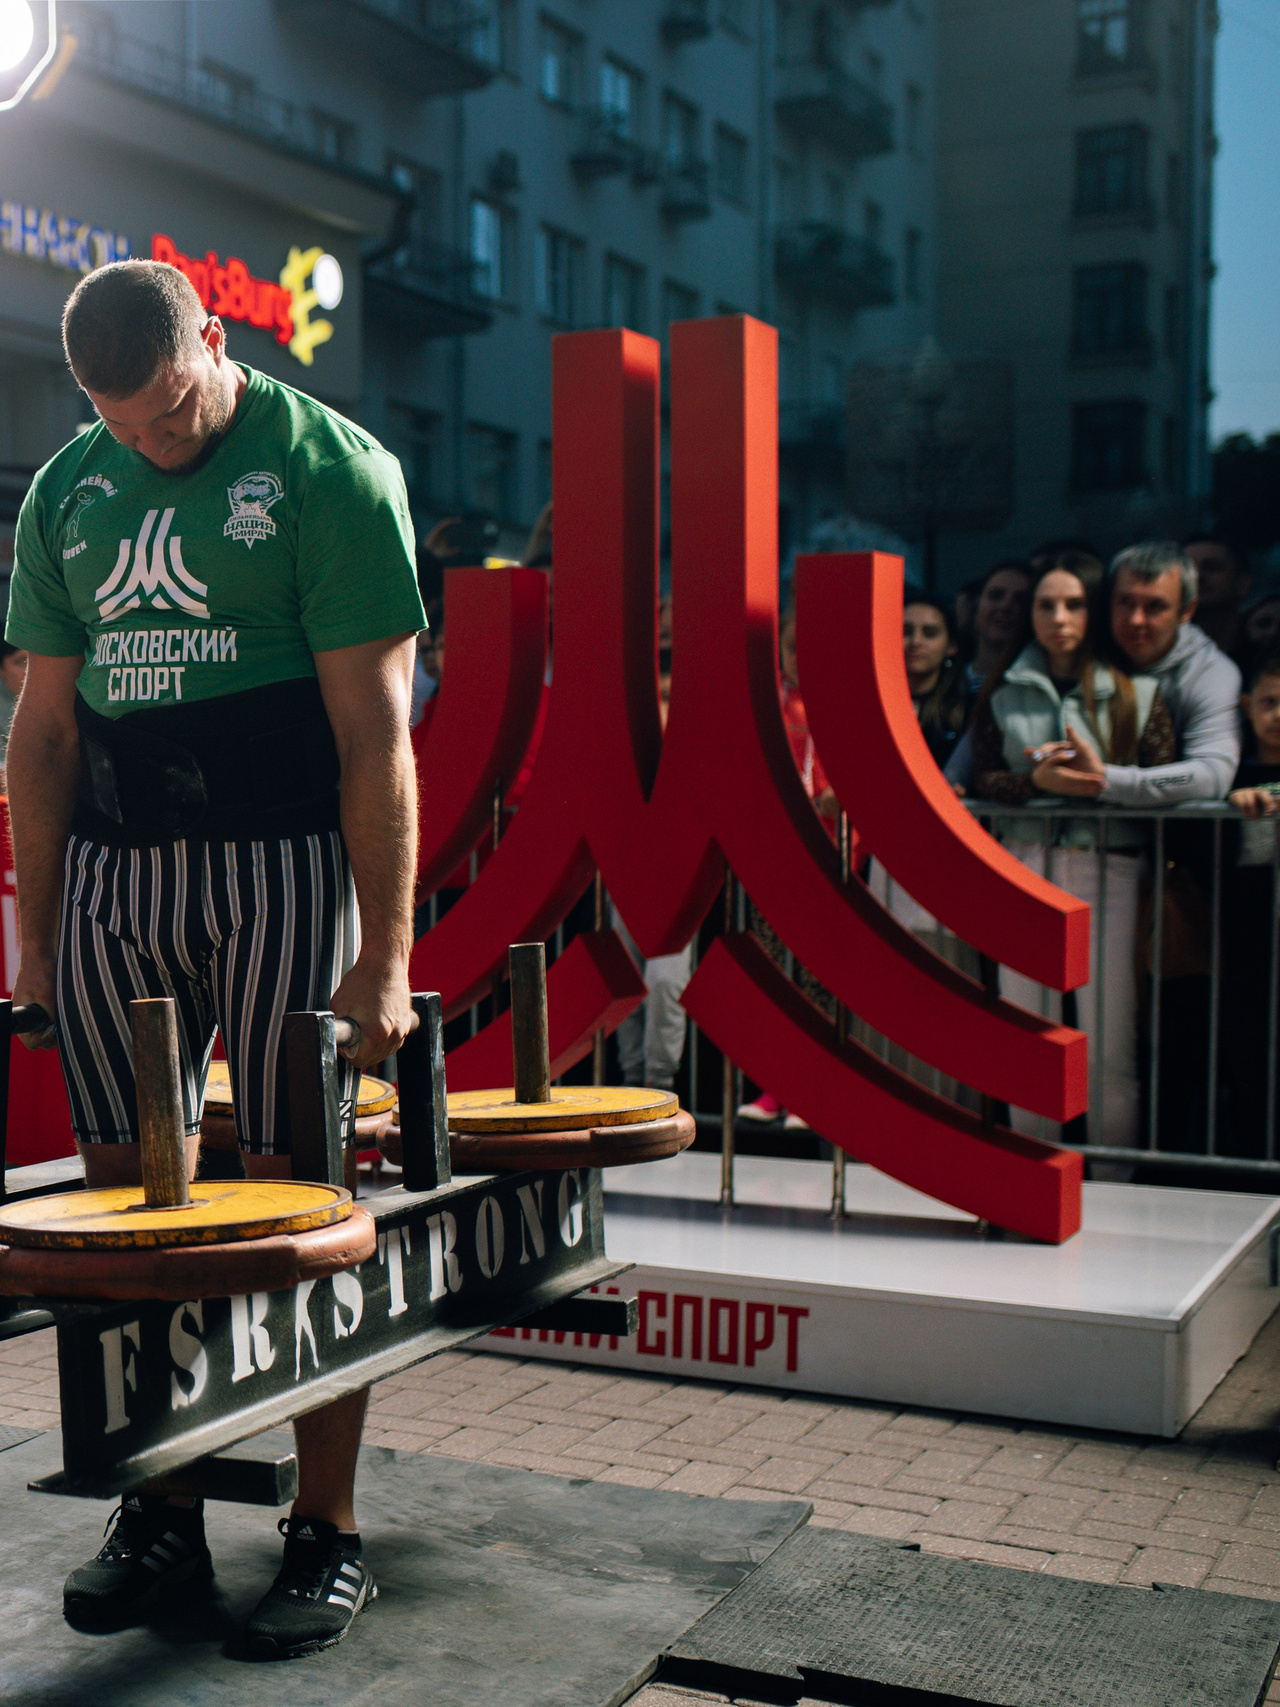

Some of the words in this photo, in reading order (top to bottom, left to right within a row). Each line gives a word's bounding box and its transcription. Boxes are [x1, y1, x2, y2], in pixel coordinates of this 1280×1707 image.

[225, 520, 274, 533] НАЦИЯ
[234, 529, 264, 538] МИРА
[108, 667, 185, 701] СПОРТ
[636, 1290, 810, 1373] СПОРТ
